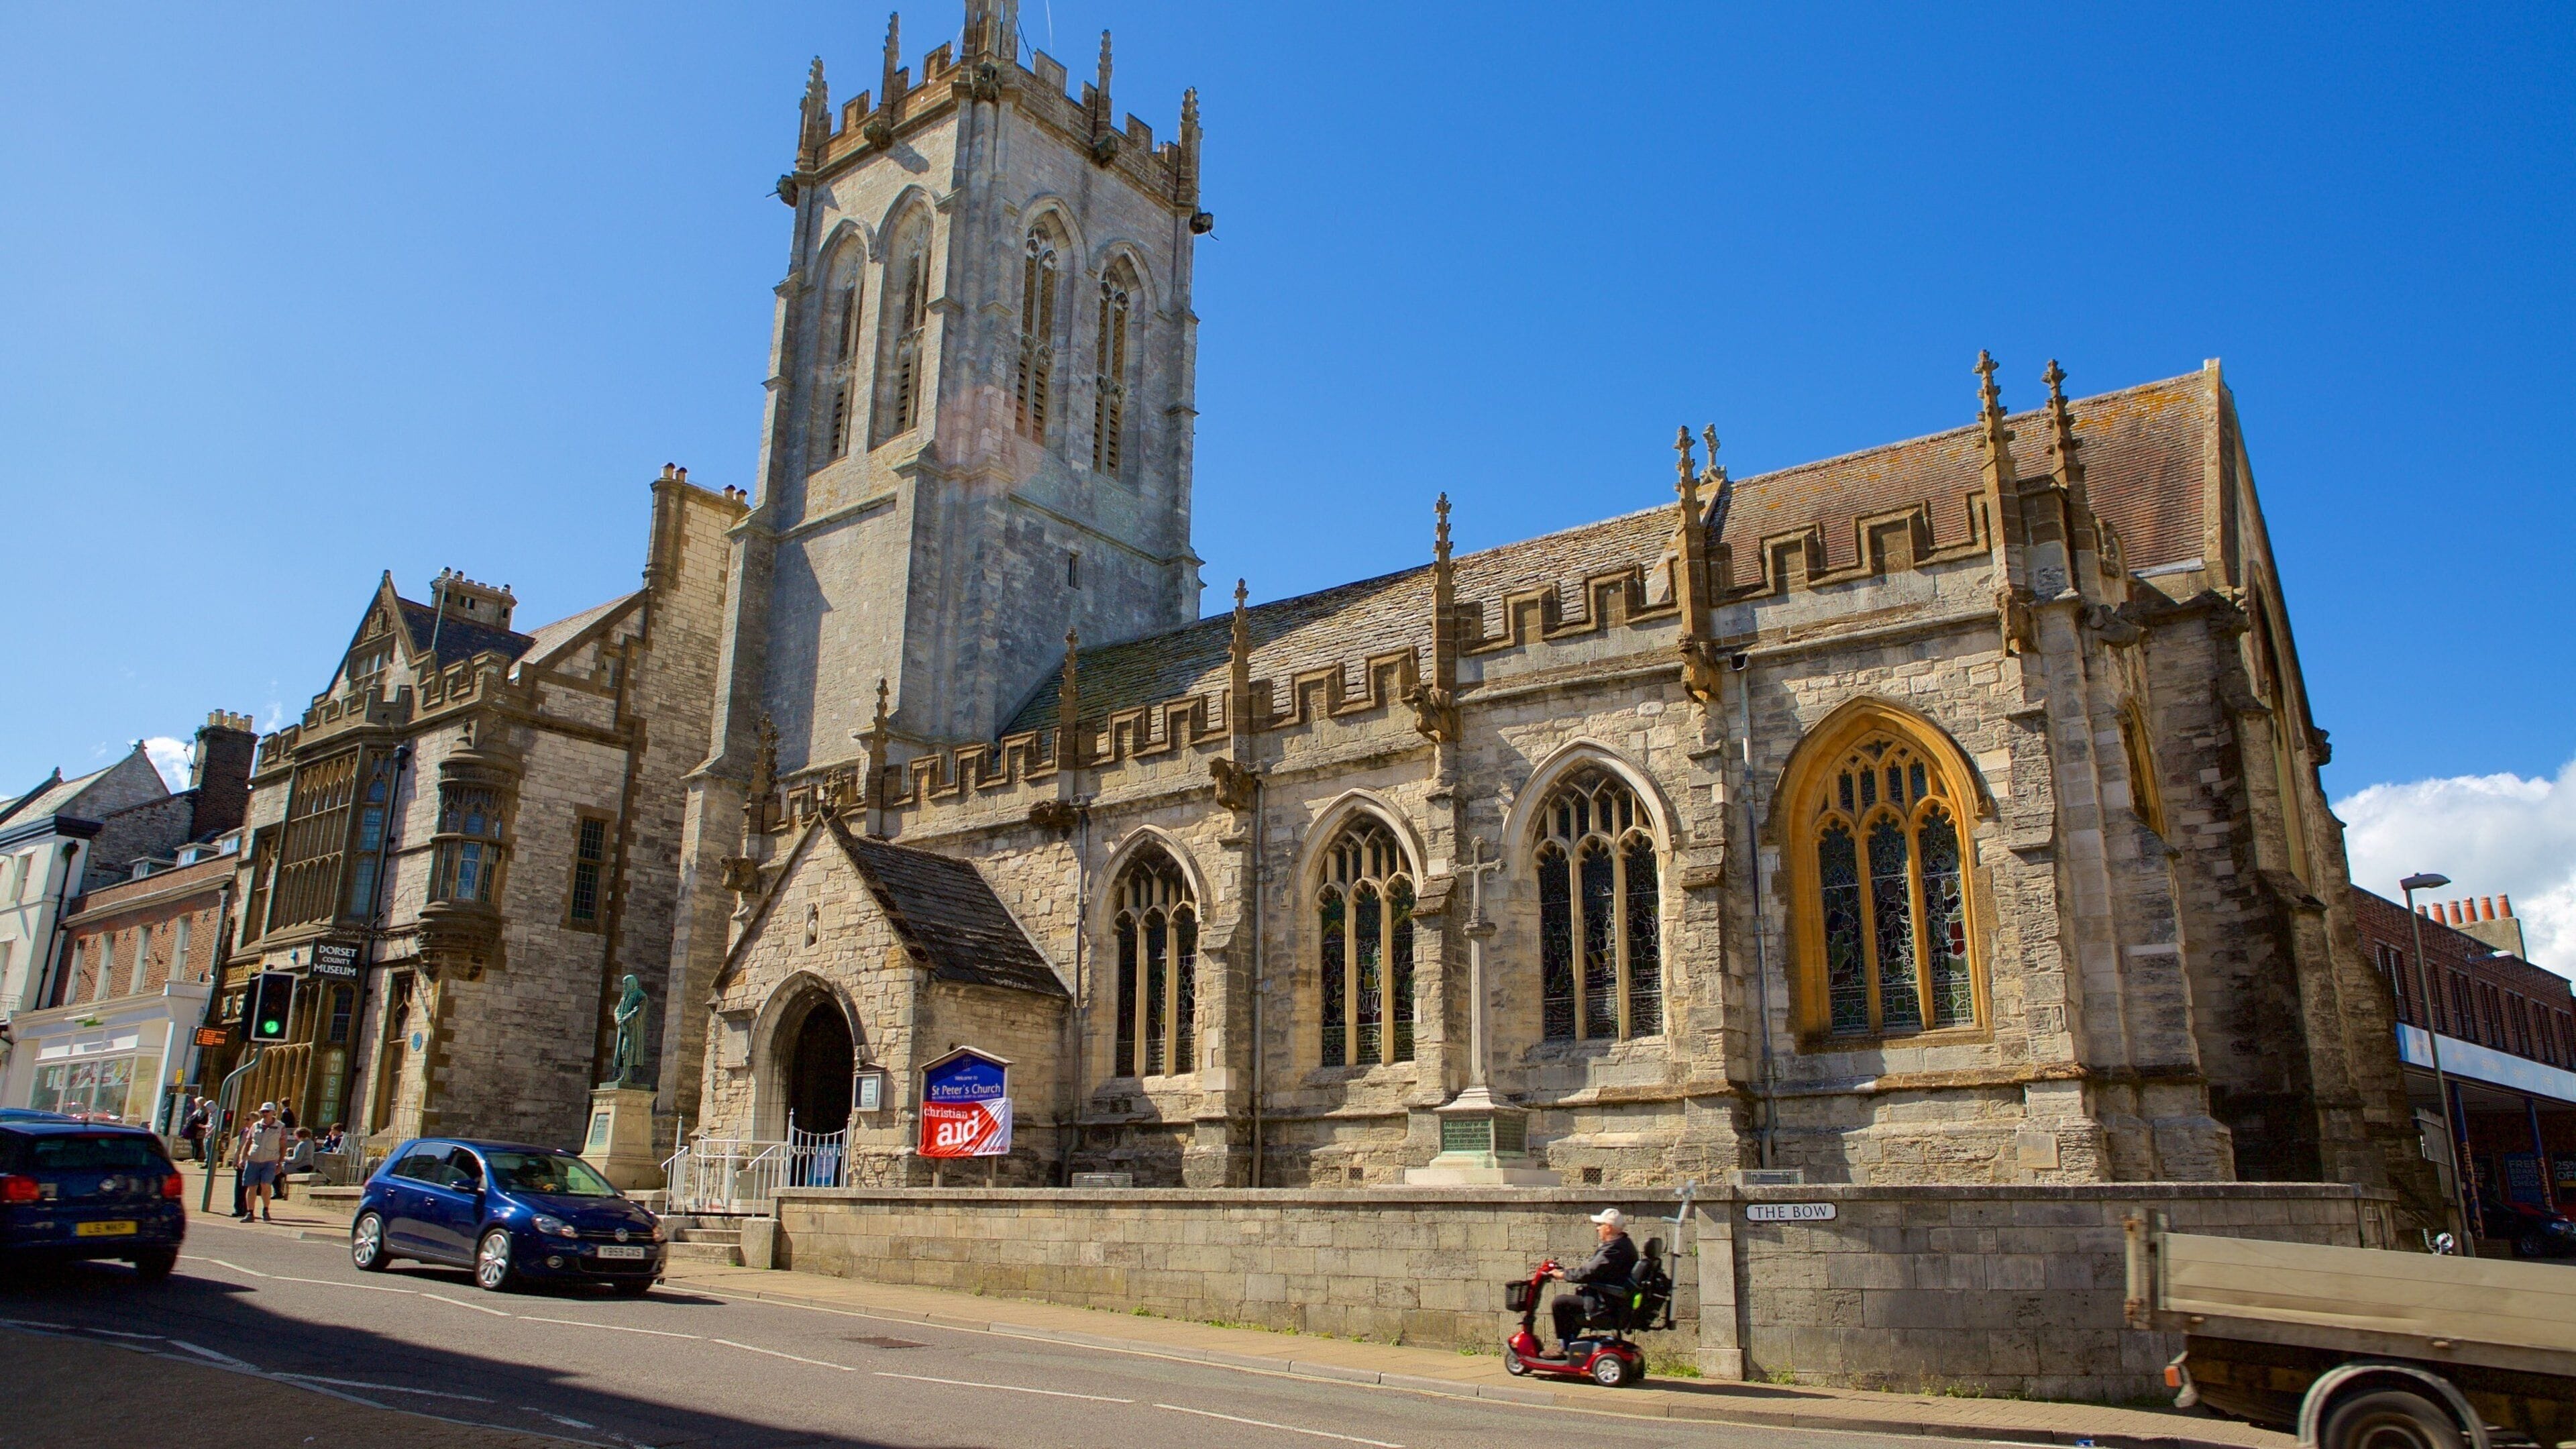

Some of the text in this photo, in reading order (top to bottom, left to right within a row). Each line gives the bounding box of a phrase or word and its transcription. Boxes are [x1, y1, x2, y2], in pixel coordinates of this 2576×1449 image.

[319, 945, 358, 958] DORSET
[322, 956, 351, 965] COUNTY
[313, 963, 357, 977] MUSEUM
[322, 1052, 341, 1122] MUSEUM
[932, 1083, 1001, 1095] St Peter's Church
[924, 1106, 968, 1119] christian
[936, 1110, 979, 1146] aid
[2509, 1160, 2537, 1168] FREE
[1755, 1205, 1827, 1218] THE BOW
